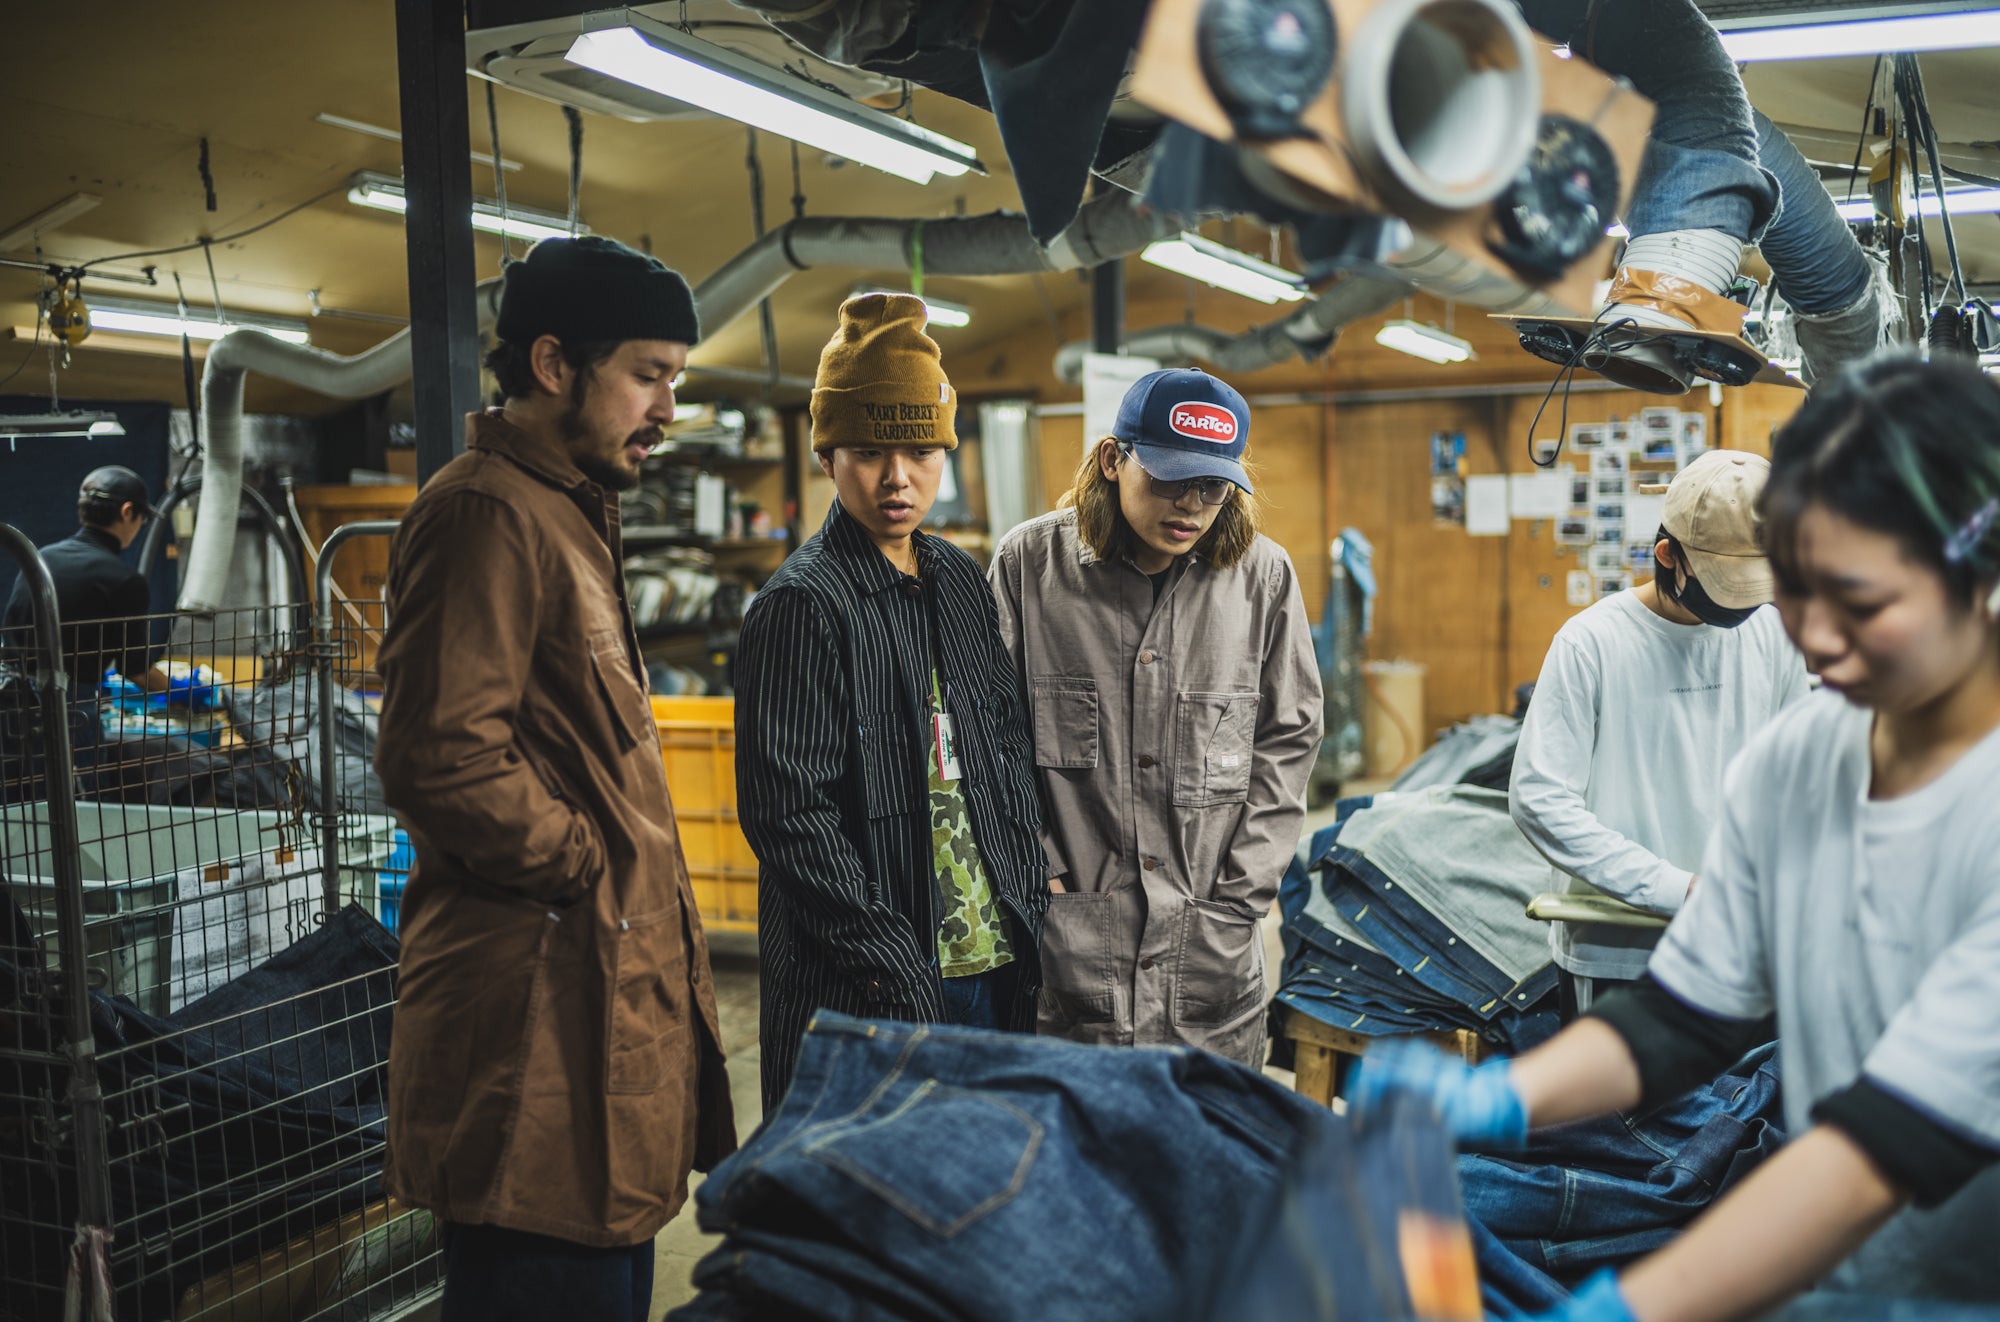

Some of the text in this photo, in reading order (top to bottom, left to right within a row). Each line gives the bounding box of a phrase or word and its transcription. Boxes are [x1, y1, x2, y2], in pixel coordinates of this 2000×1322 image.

[866, 402, 939, 420] MARY BERRY'S
[874, 422, 935, 440] GARDENING
[1175, 411, 1233, 435] FARTCO
